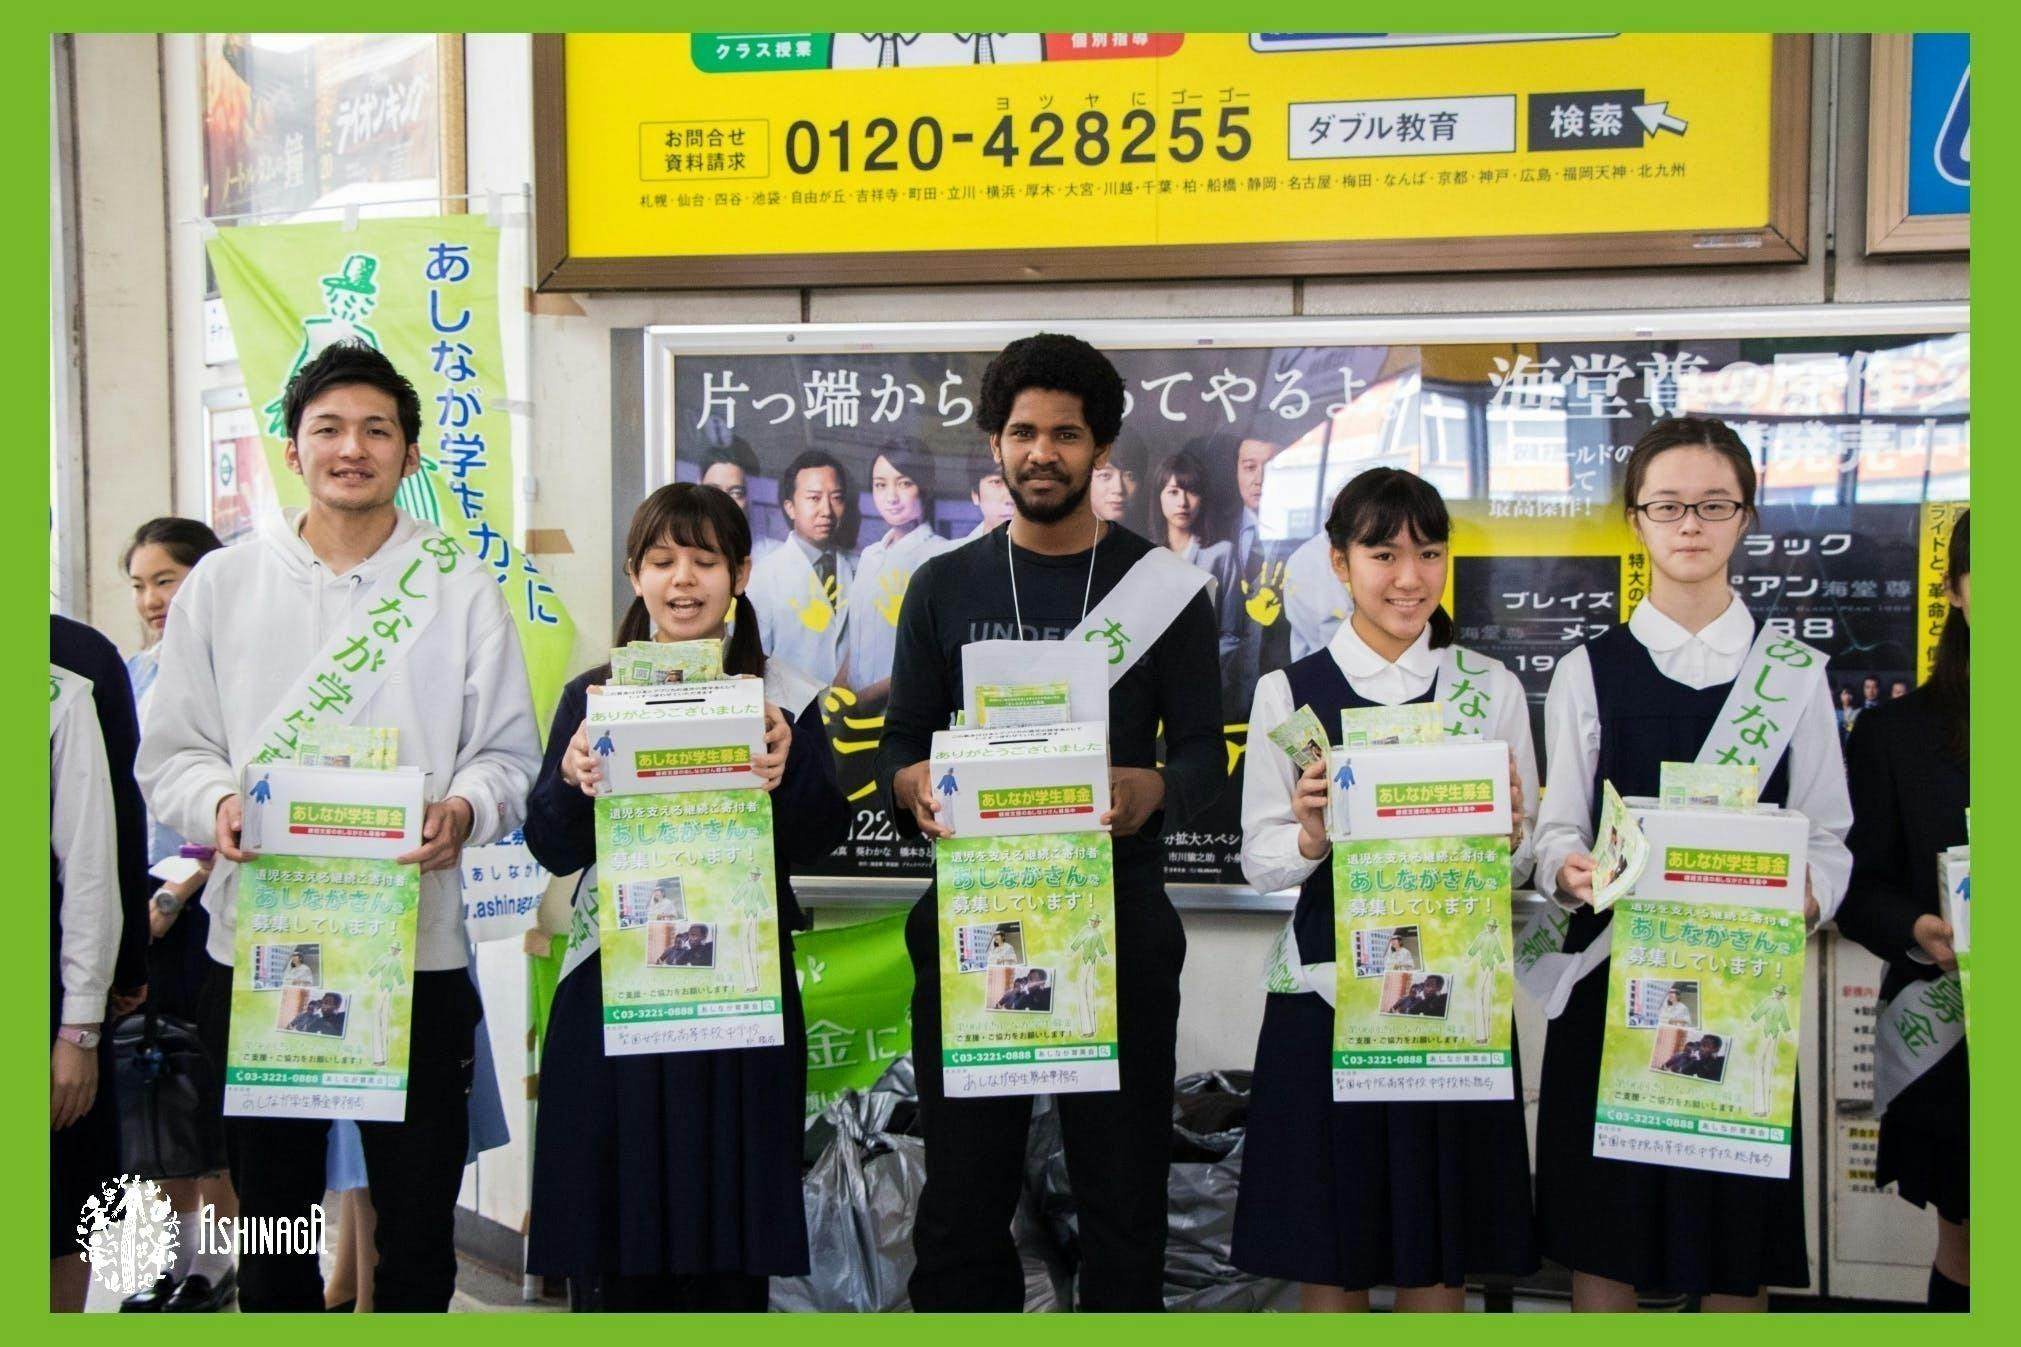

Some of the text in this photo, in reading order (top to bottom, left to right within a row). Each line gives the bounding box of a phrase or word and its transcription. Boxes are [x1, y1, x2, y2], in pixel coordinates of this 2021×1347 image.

[716, 40, 812, 60] クラス授業
[1308, 111, 1459, 145] ダブル教育
[1549, 103, 1623, 139] 検索
[665, 128, 745, 148] お問合せ
[785, 106, 1252, 175] 0120-428255
[665, 151, 745, 172] 資料請求
[590, 703, 761, 722] ありがとうございました
[639, 748, 750, 767] あしなが学生募金
[936, 742, 1103, 760] ありがとうございました
[981, 788, 1091, 807] あしなが学生募金
[1379, 783, 1491, 803] あしなが学生募金
[292, 806, 403, 827] あしなが学生募金
[1668, 851, 1787, 874] あしなが学生募金
